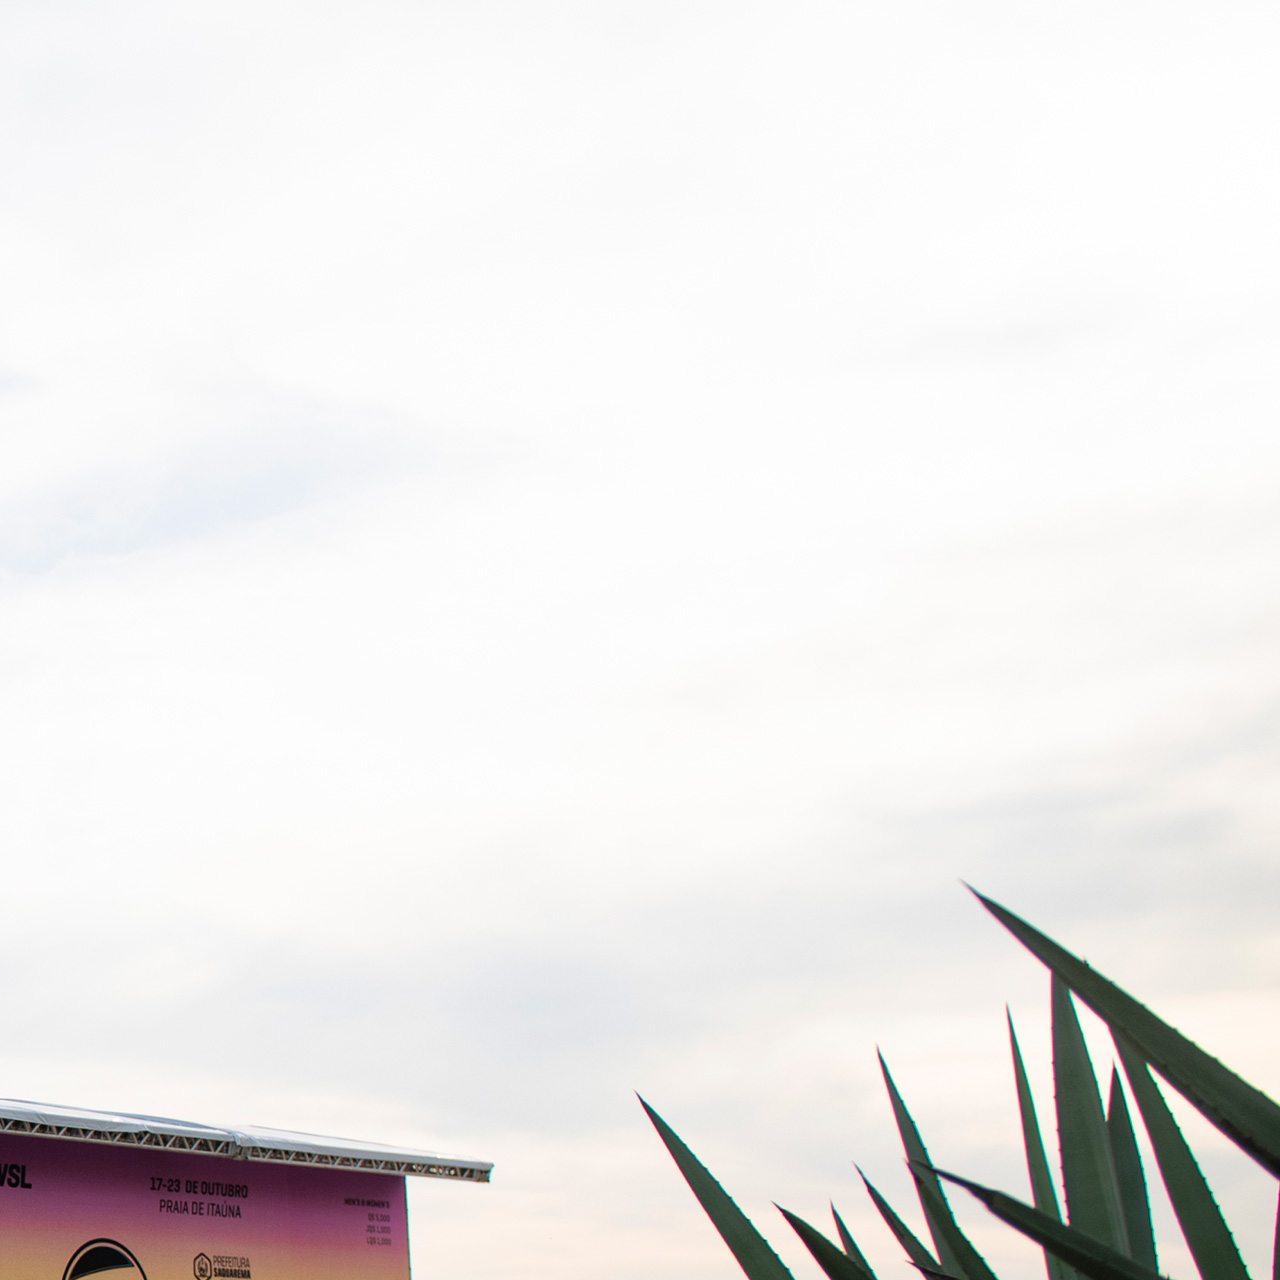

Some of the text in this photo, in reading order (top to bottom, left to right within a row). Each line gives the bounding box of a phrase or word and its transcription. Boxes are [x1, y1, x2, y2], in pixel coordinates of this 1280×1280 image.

[150, 1177, 248, 1198] 17-23 DE OUTUBRO
[160, 1199, 241, 1218] PRAIA DE ITAÚNA
[213, 1255, 251, 1268] PREFEITURA
[213, 1267, 252, 1279] SAQUAREMA
